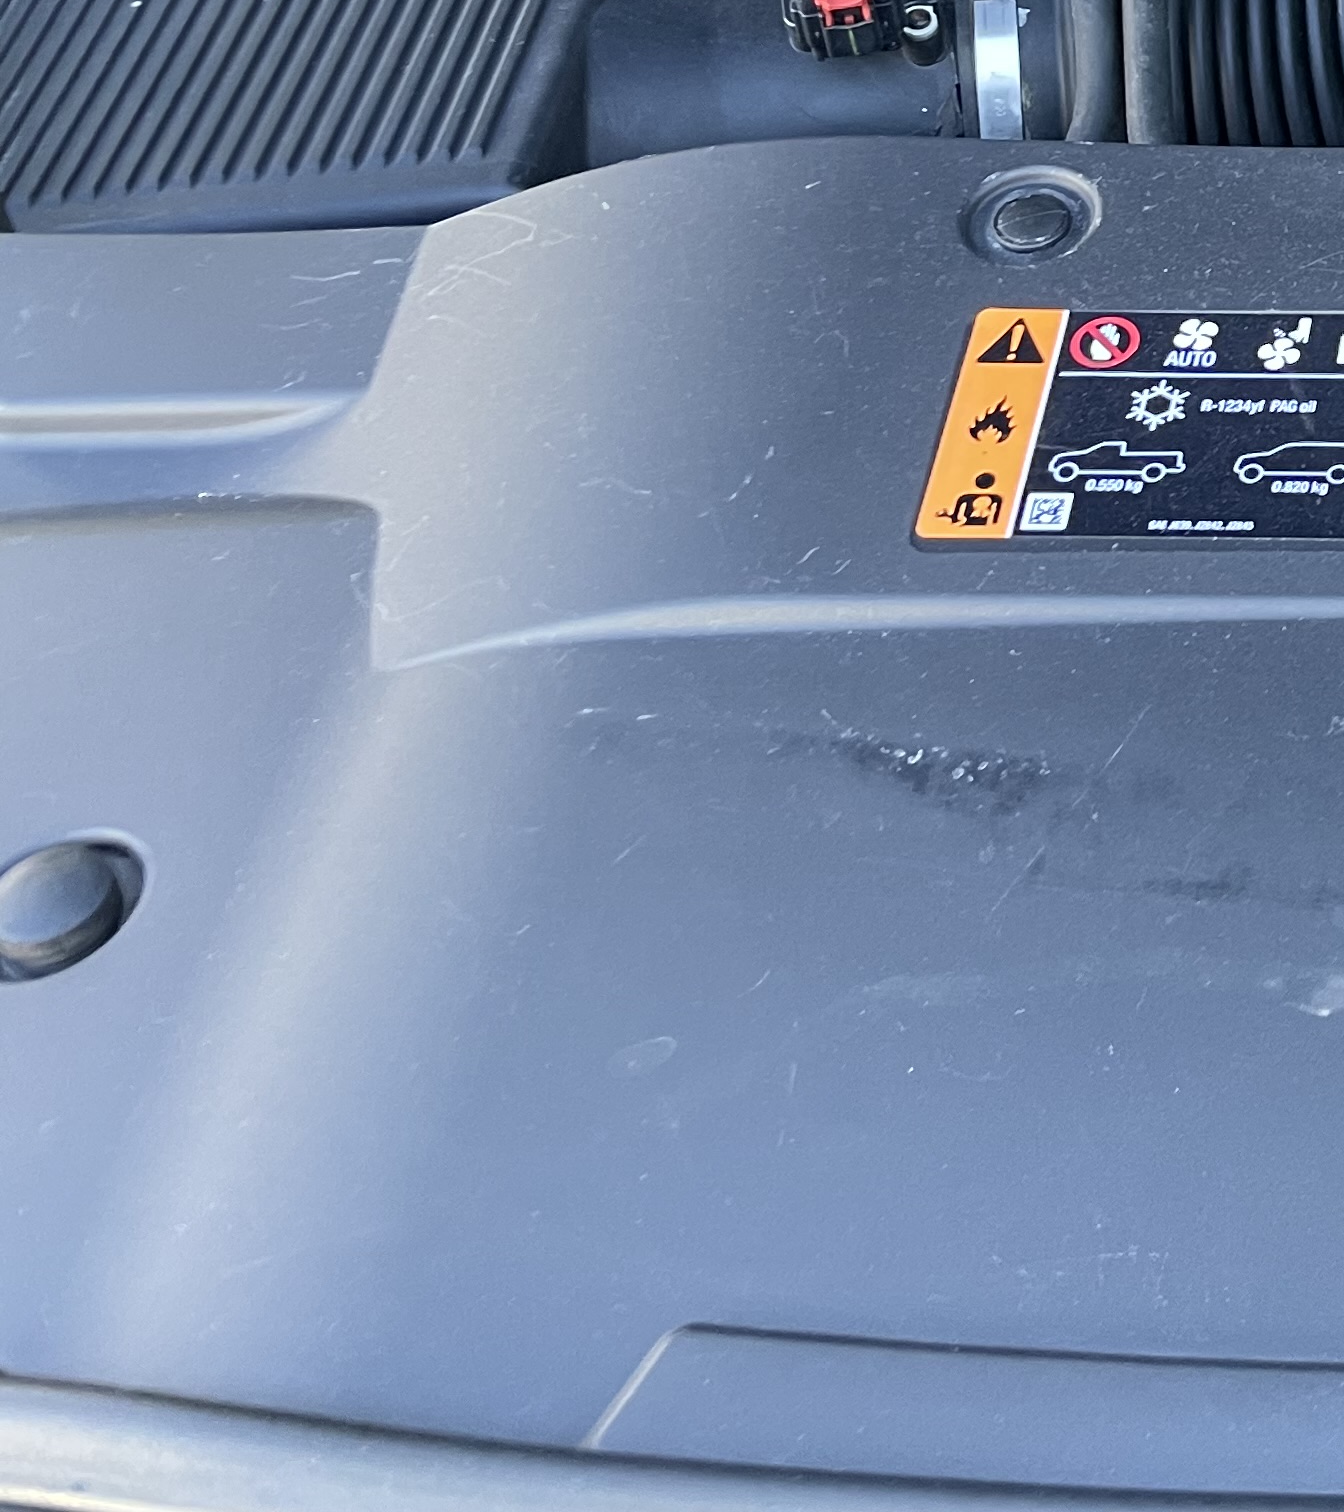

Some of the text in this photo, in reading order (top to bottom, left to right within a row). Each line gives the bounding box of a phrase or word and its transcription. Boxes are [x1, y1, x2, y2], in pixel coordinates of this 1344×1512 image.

[1163, 351, 1217, 367] AUTO
[1269, 400, 1298, 413] PAG
[1299, 400, 1318, 413] oil
[1084, 479, 1144, 494] 0.550 kg
[1271, 480, 1329, 496] 0.820 kg
